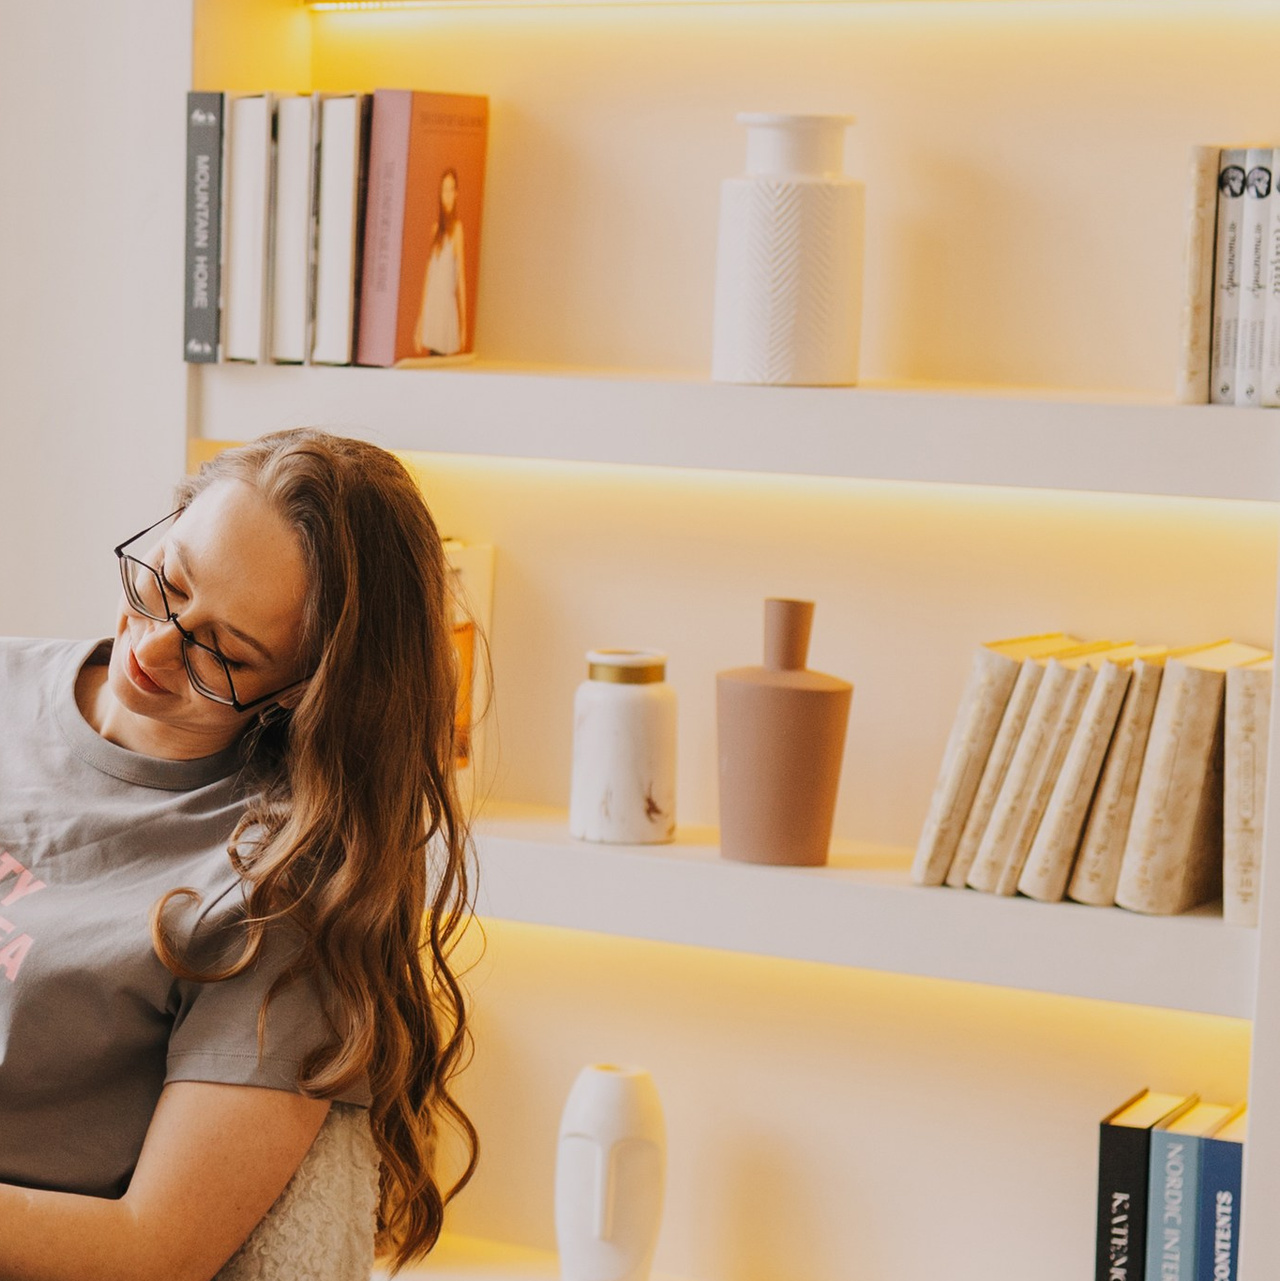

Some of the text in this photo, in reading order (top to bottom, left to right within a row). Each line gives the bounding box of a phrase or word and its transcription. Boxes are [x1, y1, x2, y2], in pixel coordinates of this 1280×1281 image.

[192, 155, 210, 309] MOUNTAIN HOME
[1164, 1142, 1185, 1224] NORDIC
